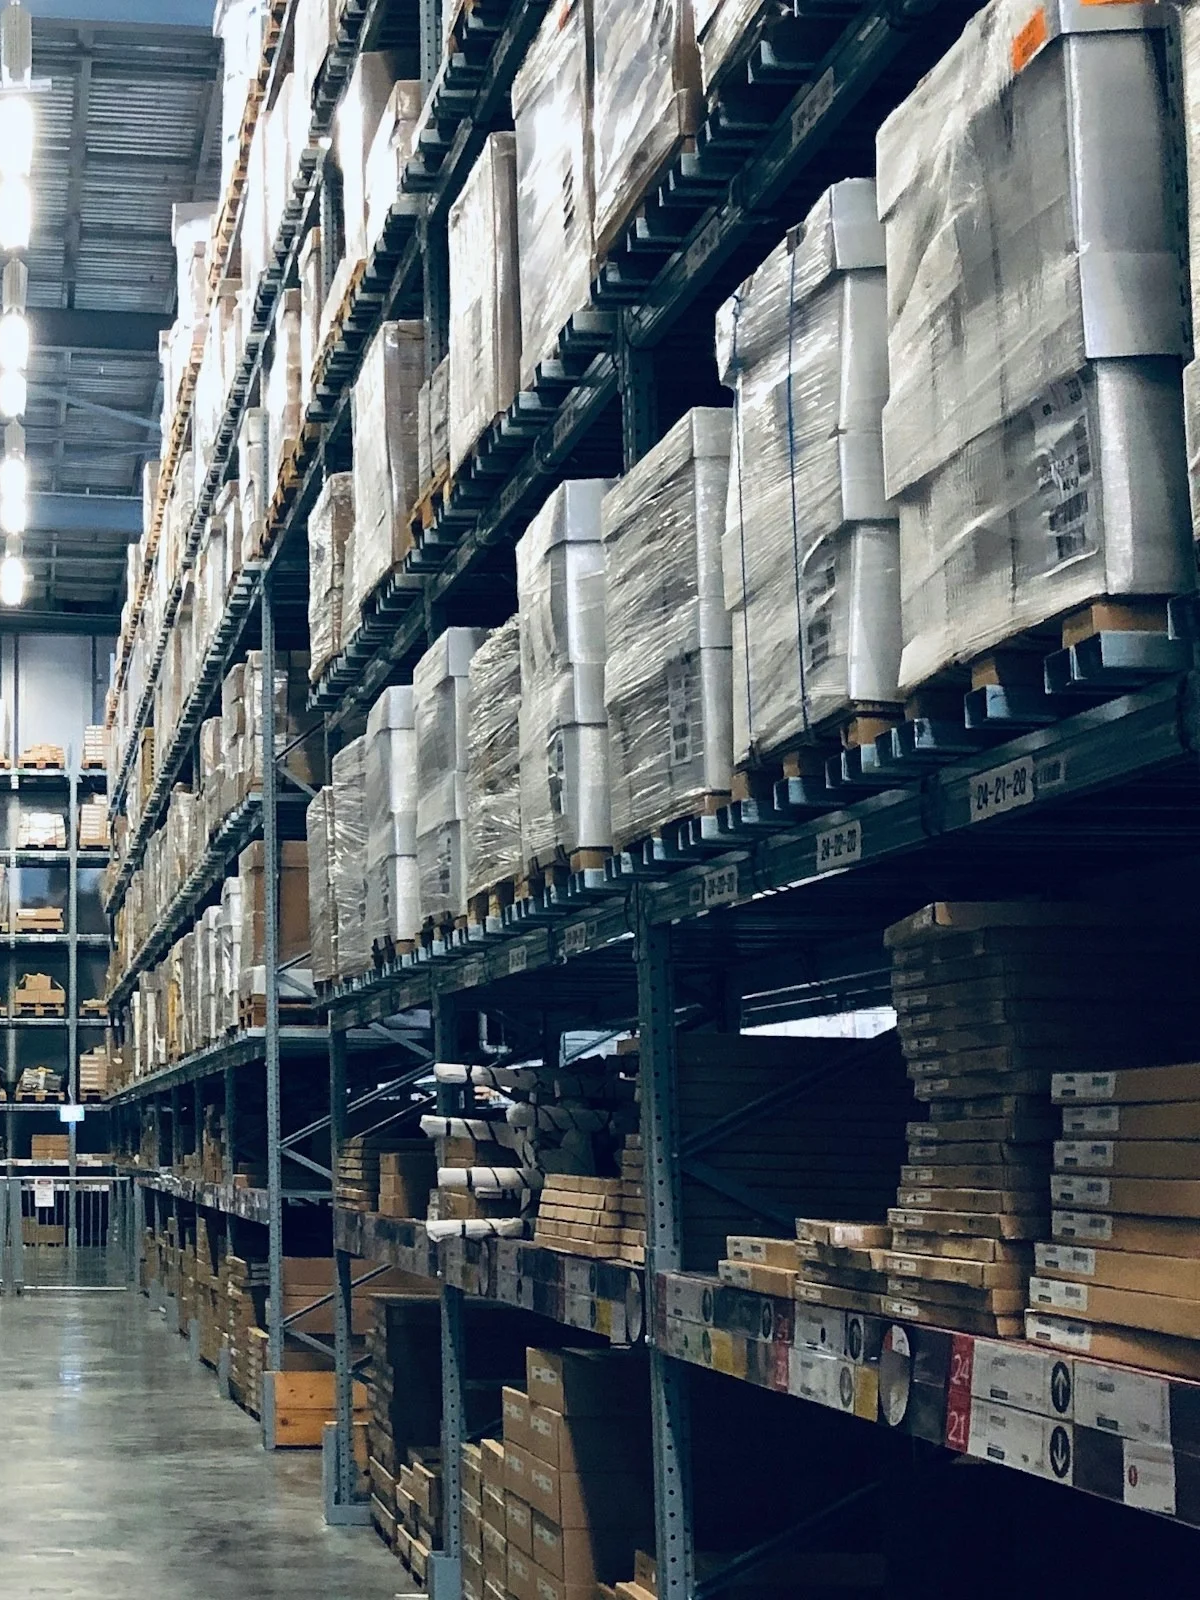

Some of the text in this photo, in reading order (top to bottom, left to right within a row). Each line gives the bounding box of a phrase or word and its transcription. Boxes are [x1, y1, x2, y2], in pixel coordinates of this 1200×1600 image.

[976, 766, 1027, 811] 24-21-20
[951, 1354, 970, 1386] 24
[947, 1411, 966, 1444] 21
